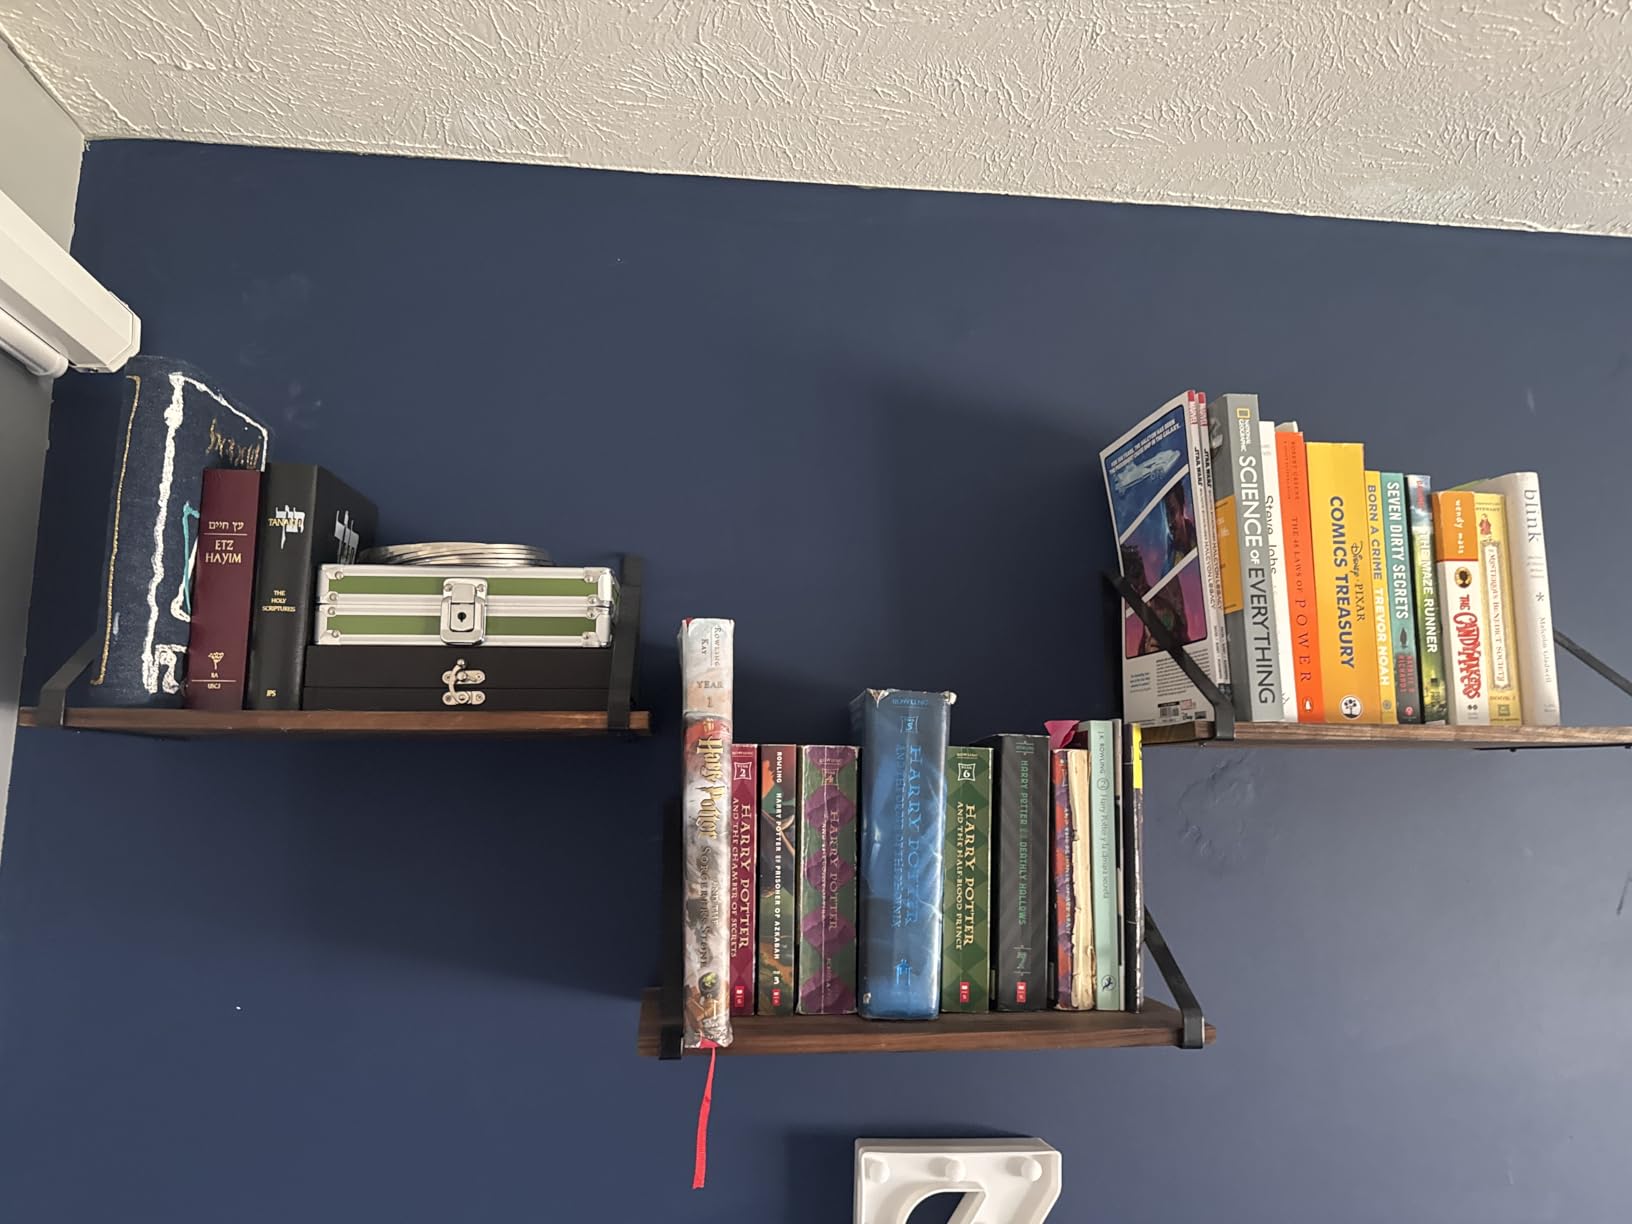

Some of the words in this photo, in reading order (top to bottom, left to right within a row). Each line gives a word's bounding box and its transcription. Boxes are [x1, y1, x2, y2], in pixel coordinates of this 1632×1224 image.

[1203, 448, 1211, 467] STAR
[1239, 456, 1262, 547] SCIENCE
[1367, 485, 1378, 521] BORN
[1387, 481, 1402, 520] SEVEN
[1455, 499, 1465, 529] wendy
[1524, 490, 1541, 543] blink
[209, 521, 229, 530] חיים
[215, 540, 234, 550] ETZ
[232, 521, 244, 532] עץ
[1291, 517, 1299, 536] THE
[1330, 496, 1348, 567] COMICS
[1370, 526, 1379, 535] A
[1390, 525, 1404, 560] DIRTY
[1420, 533, 1430, 556] THE
[205, 553, 242, 565] HAYIM
[1250, 551, 1261, 565] OF
[1294, 551, 1302, 577] LAWS
[1351, 541, 1363, 577] Disney
[1371, 539, 1382, 579] CRIME
[1421, 560, 1434, 595] MAZE
[1296, 580, 1303, 593] OF
[1355, 584, 1365, 621] PIXAR
[1392, 564, 1408, 619] SECRETS
[1459, 594, 1470, 611] THE
[262, 605, 296, 613] SCRIPTURES
[1335, 574, 1354, 669] TREASURY
[1375, 587, 1387, 641] TREVOR
[1423, 599, 1438, 653] RUNNER
[1493, 601, 1502, 643] BENEDICT
[701, 638, 709, 655] KAY
[714, 625, 722, 667] ROWLING
[1249, 568, 1275, 703] EVERYTHING
[1296, 600, 1311, 681] POWER
[1378, 645, 1390, 686] NOAH
[1453, 612, 1481, 699] CANDYMAKERS
[696, 681, 723, 689] YEAR
[696, 735, 724, 783] Harry
[739, 769, 746, 777] 2
[963, 769, 970, 778] 6
[1020, 760, 1028, 790] HARRY
[907, 745, 922, 832] HARRY
[695, 784, 726, 840] Potter
[1020, 792, 1028, 825] POTTER
[740, 804, 752, 873] HARRY
[830, 811, 839, 866] HARRY
[964, 804, 976, 871] HARRY
[956, 849, 964, 910] HALF-BLOOD
[1019, 841, 1027, 880] DEATHLY
[731, 902, 738, 915] OF
[738, 879, 751, 949] POTTER
[775, 907, 781, 918] OF
[829, 873, 838, 931] POTTER
[963, 878, 975, 946] POTTER
[1018, 883, 1027, 925] HALLOWS
[774, 921, 782, 960] AZKABAN
